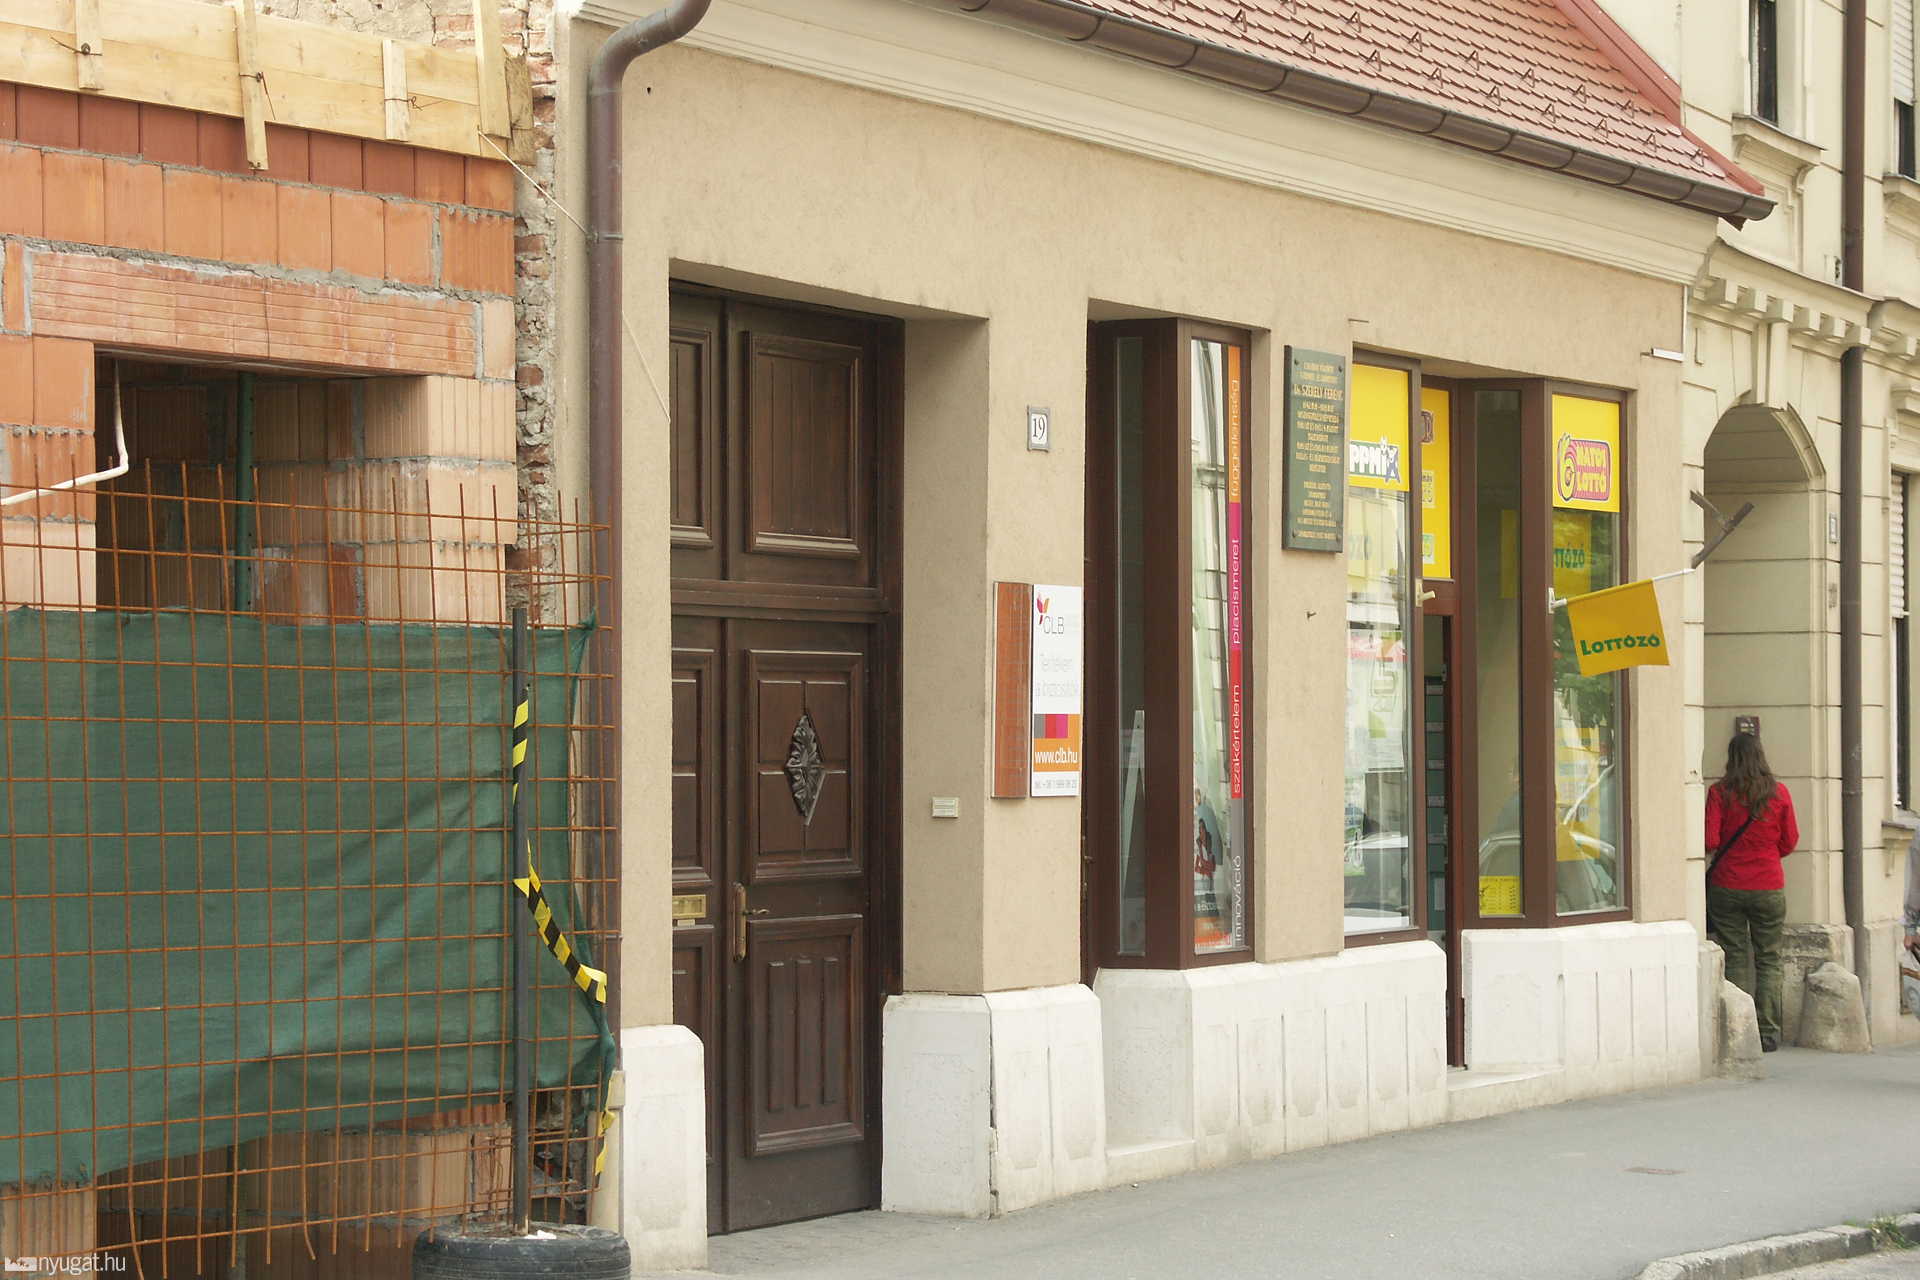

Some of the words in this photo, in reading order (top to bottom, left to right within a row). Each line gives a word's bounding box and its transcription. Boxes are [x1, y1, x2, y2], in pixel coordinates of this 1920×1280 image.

[1033, 415, 1046, 440] 19
[1034, 746, 1078, 764] www.clb.hu
[1232, 685, 1241, 794] szakértelem
[1232, 855, 1242, 941] innováció
